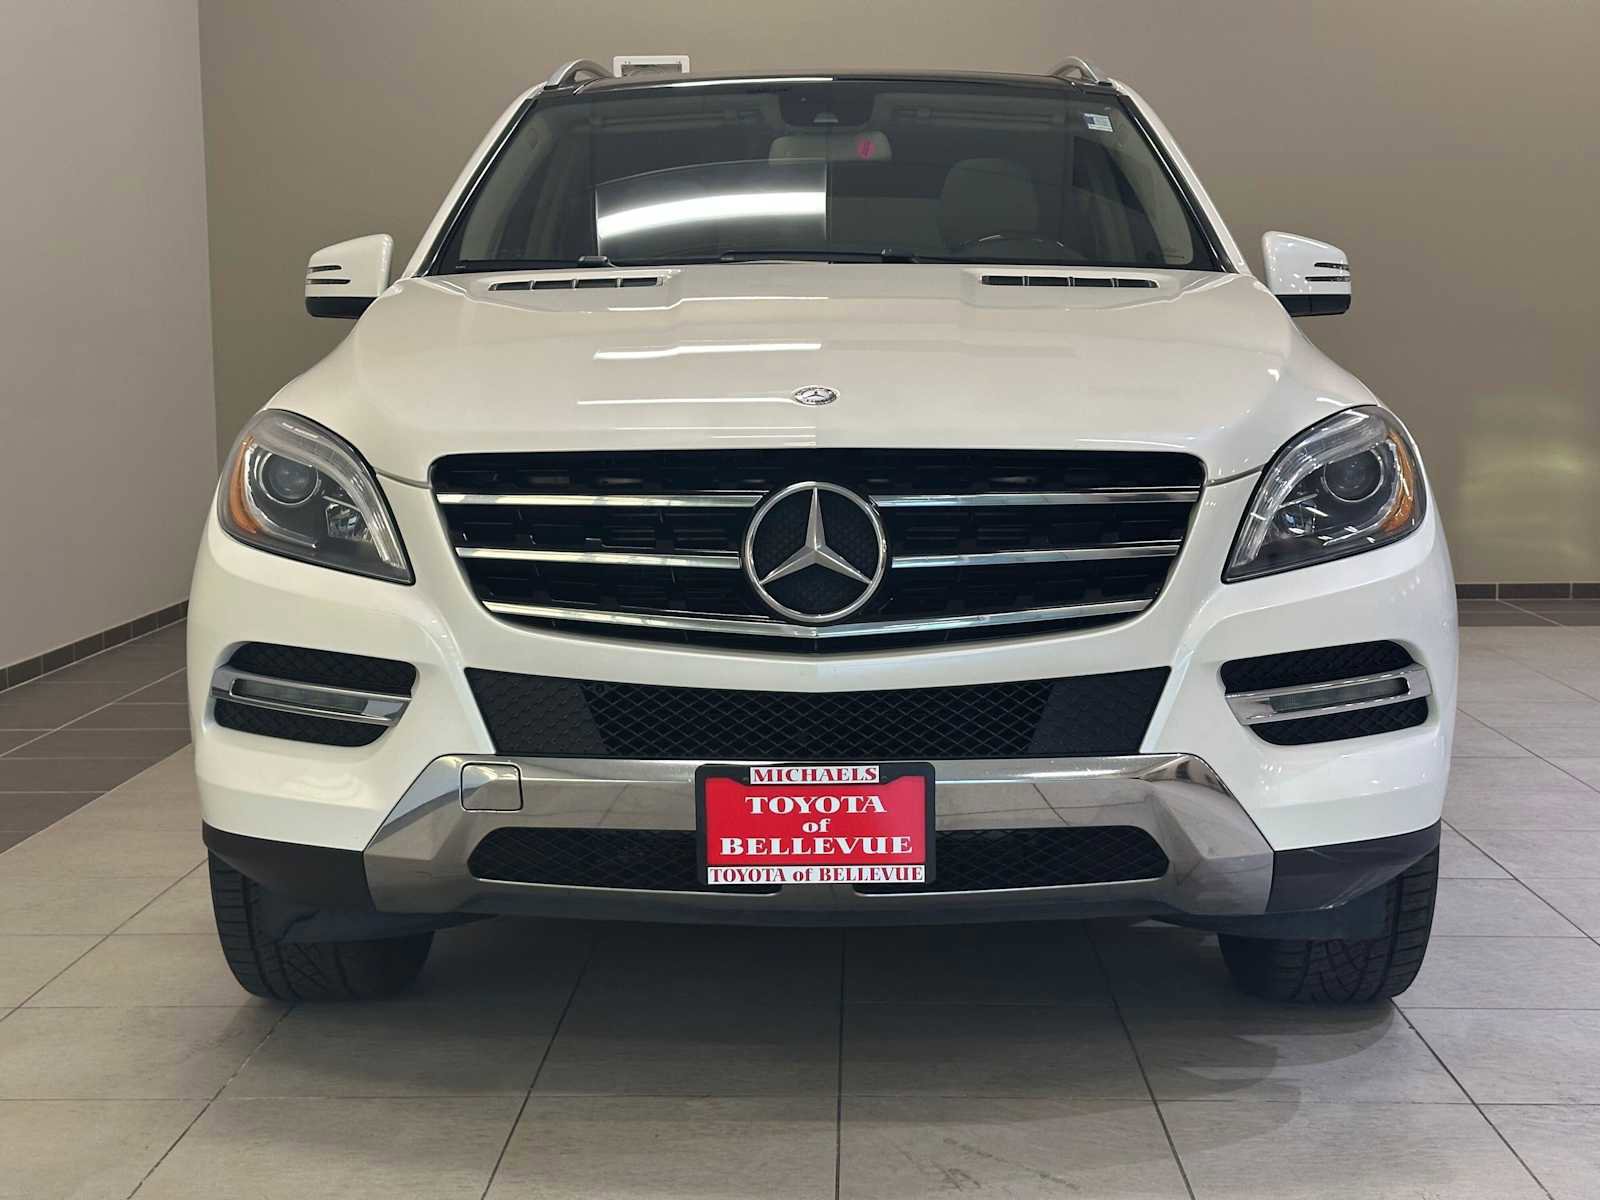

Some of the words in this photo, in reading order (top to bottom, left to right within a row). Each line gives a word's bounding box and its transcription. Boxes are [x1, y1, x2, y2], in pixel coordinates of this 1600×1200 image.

[752, 767, 878, 783] MICHAELS
[744, 795, 887, 814] TOYOTA
[802, 818, 832, 833] of
[719, 836, 913, 856] BELLEVUE
[709, 868, 786, 883] TOYOTA
[792, 868, 814, 882] of
[818, 866, 923, 882] BELLEVUE
